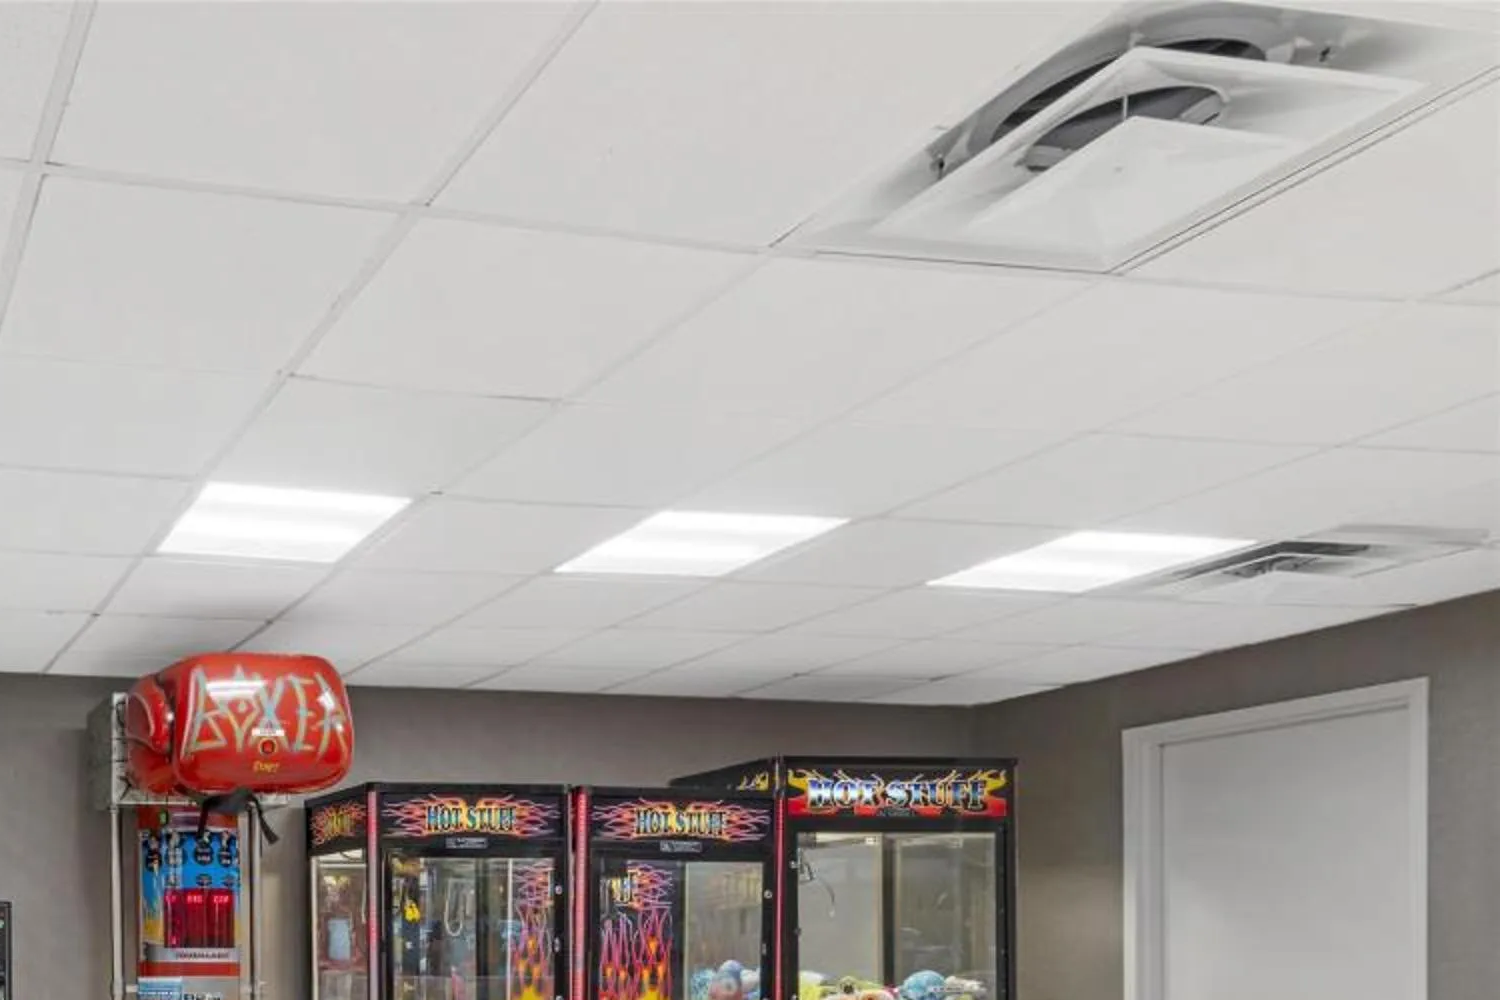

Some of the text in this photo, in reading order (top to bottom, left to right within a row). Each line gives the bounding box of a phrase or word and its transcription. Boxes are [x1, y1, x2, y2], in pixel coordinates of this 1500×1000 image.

[807, 777, 987, 811] HOT STUFF
[426, 804, 517, 832] HOT STUFF
[636, 809, 726, 836] HOT STUFF
